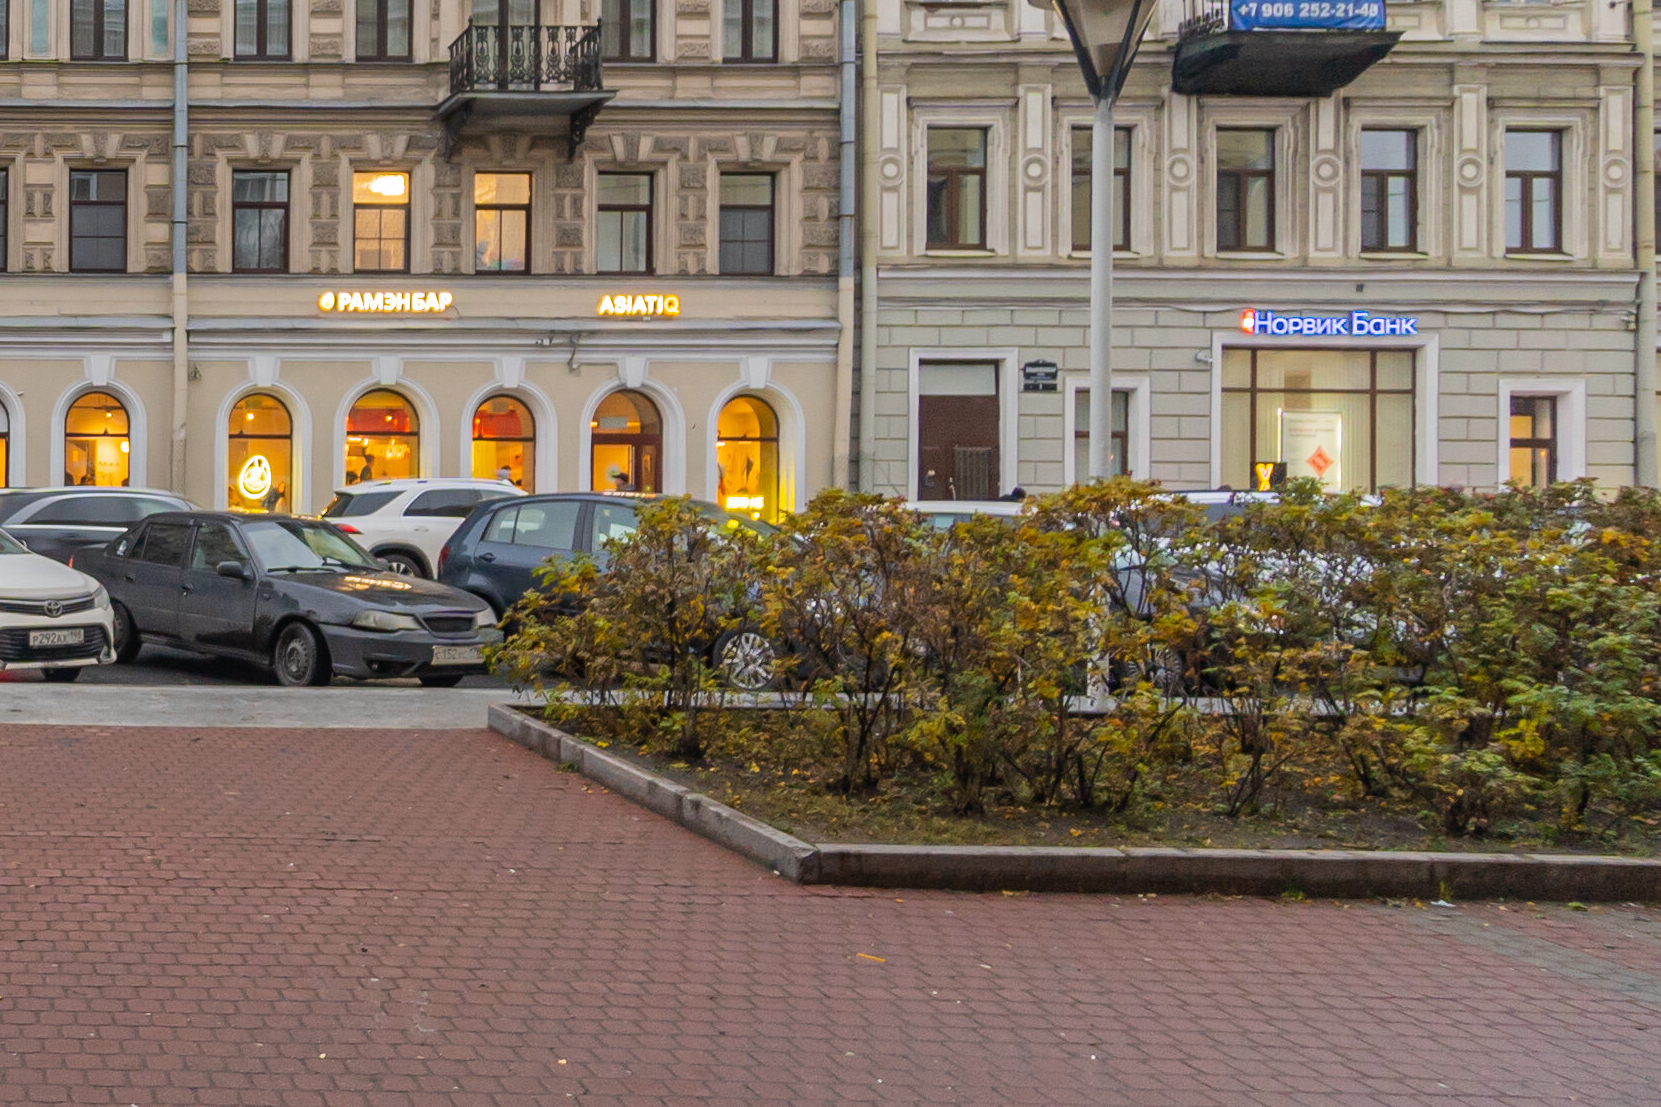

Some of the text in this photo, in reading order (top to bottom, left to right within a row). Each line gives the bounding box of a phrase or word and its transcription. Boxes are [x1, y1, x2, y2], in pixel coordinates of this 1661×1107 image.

[1238, 3, 1258, 18] +7
[1261, 3, 1295, 18] 906
[598, 294, 680, 315] ASIATIQ
[1351, 310, 1418, 335] Банк
